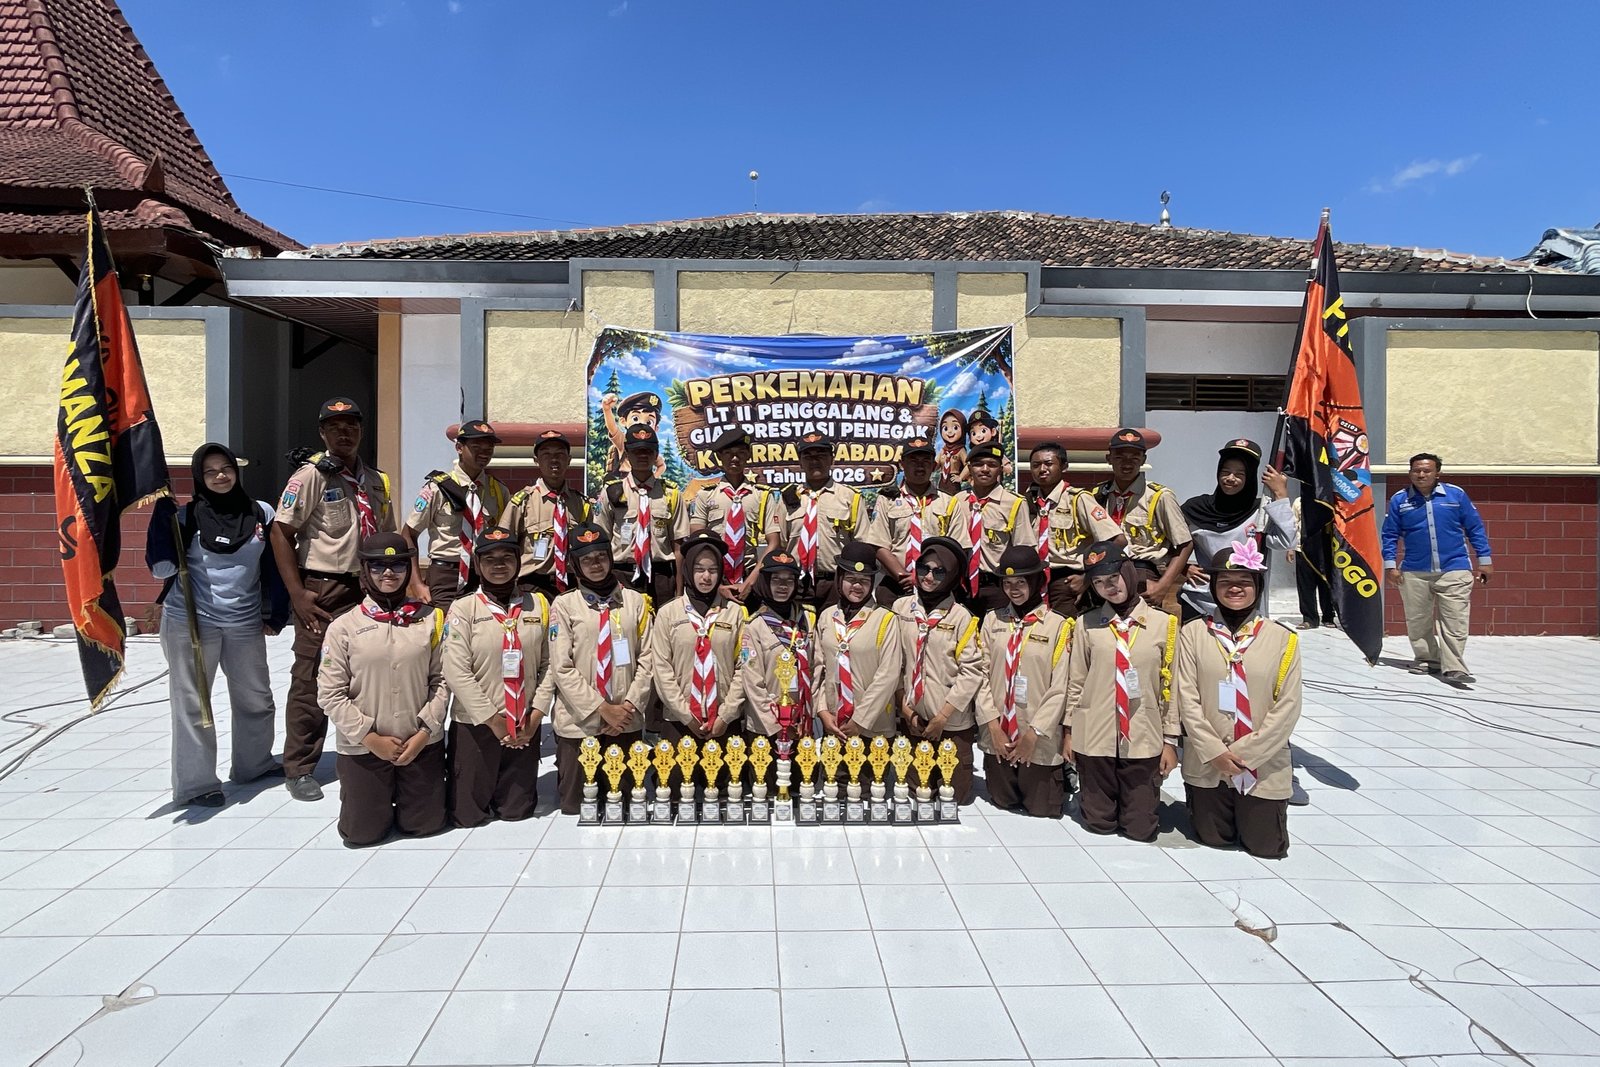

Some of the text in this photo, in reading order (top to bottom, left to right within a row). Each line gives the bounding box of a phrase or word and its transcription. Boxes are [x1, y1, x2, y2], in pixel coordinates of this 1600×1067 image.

[688, 372, 922, 406] PERKEMAHAN
[706, 403, 912, 424] LT II PENGGALANG &
[840, 422, 929, 439] PENEGAK
[829, 468, 866, 483] 026
